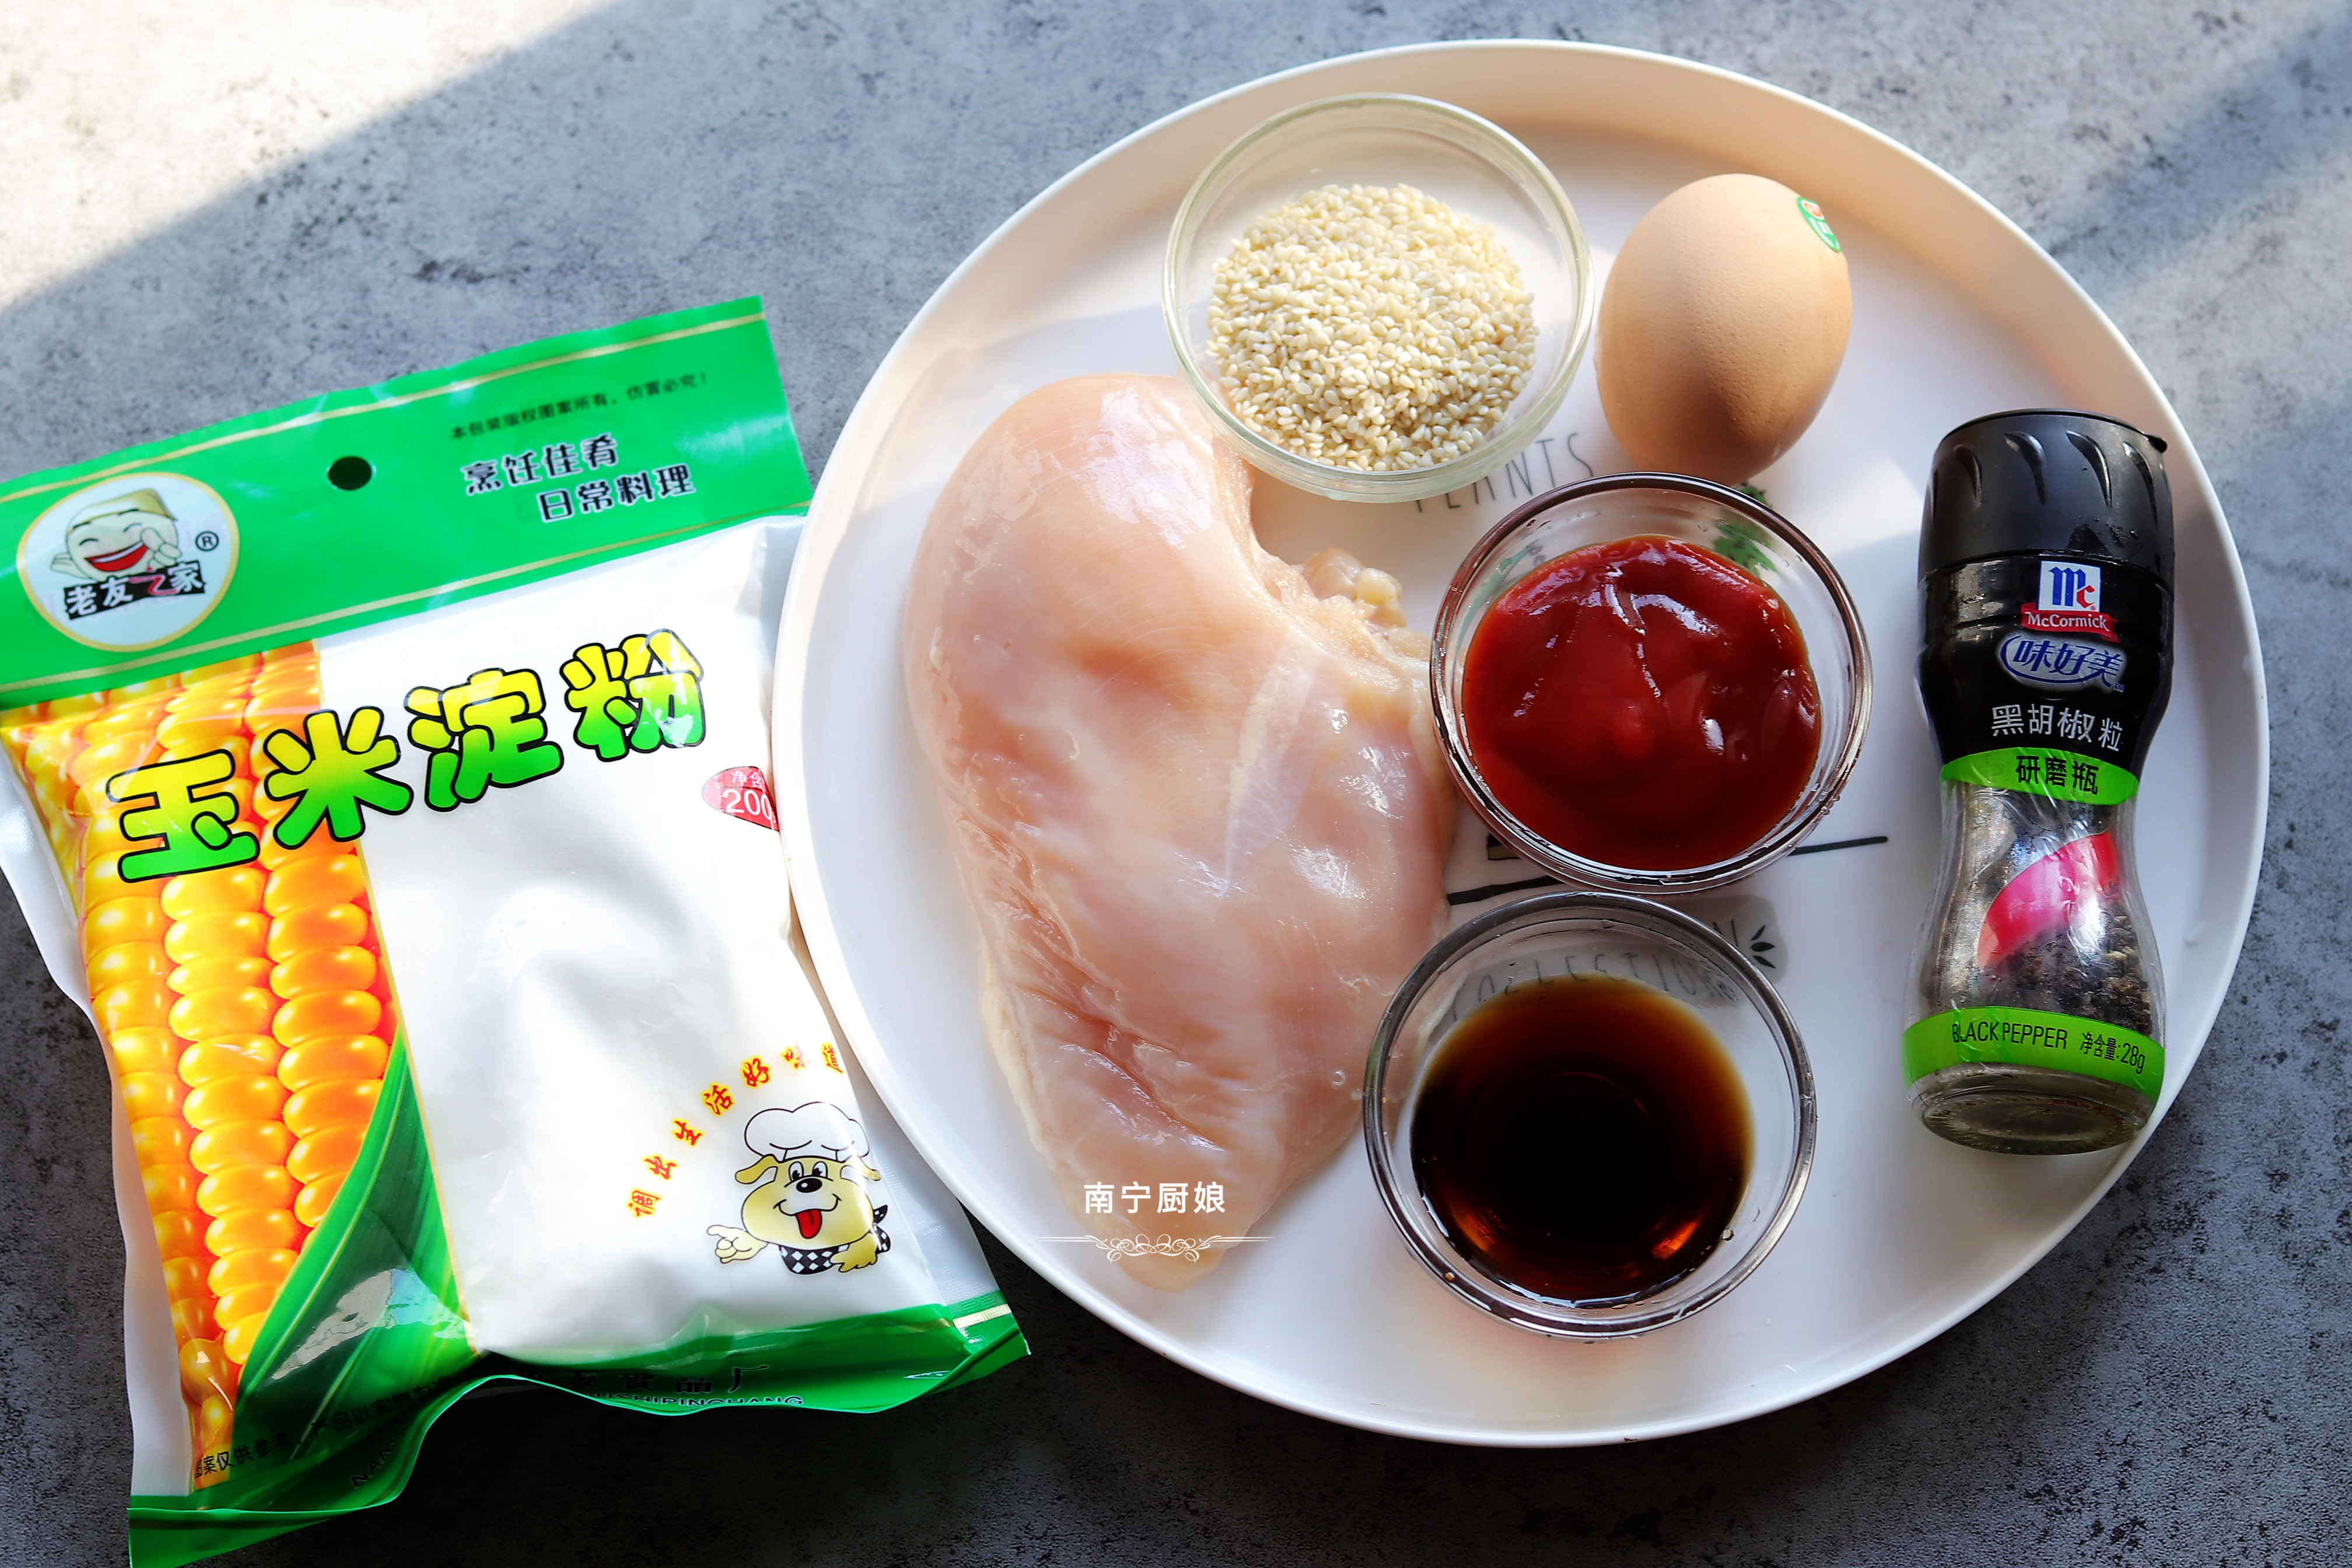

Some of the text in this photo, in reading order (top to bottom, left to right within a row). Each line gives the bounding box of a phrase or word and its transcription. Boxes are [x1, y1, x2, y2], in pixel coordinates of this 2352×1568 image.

[461, 432, 618, 496] 烹饪佳肴
[537, 463, 696, 523] 日常料理
[64, 561, 204, 618] 老友之家
[2024, 611, 2110, 632] McCormick
[2011, 639, 2124, 688] 味好美
[1991, 703, 2123, 752] 黑胡椒粒
[106, 628, 707, 884] 玉米淀粉
[2015, 755, 2099, 795] 研磨瓶
